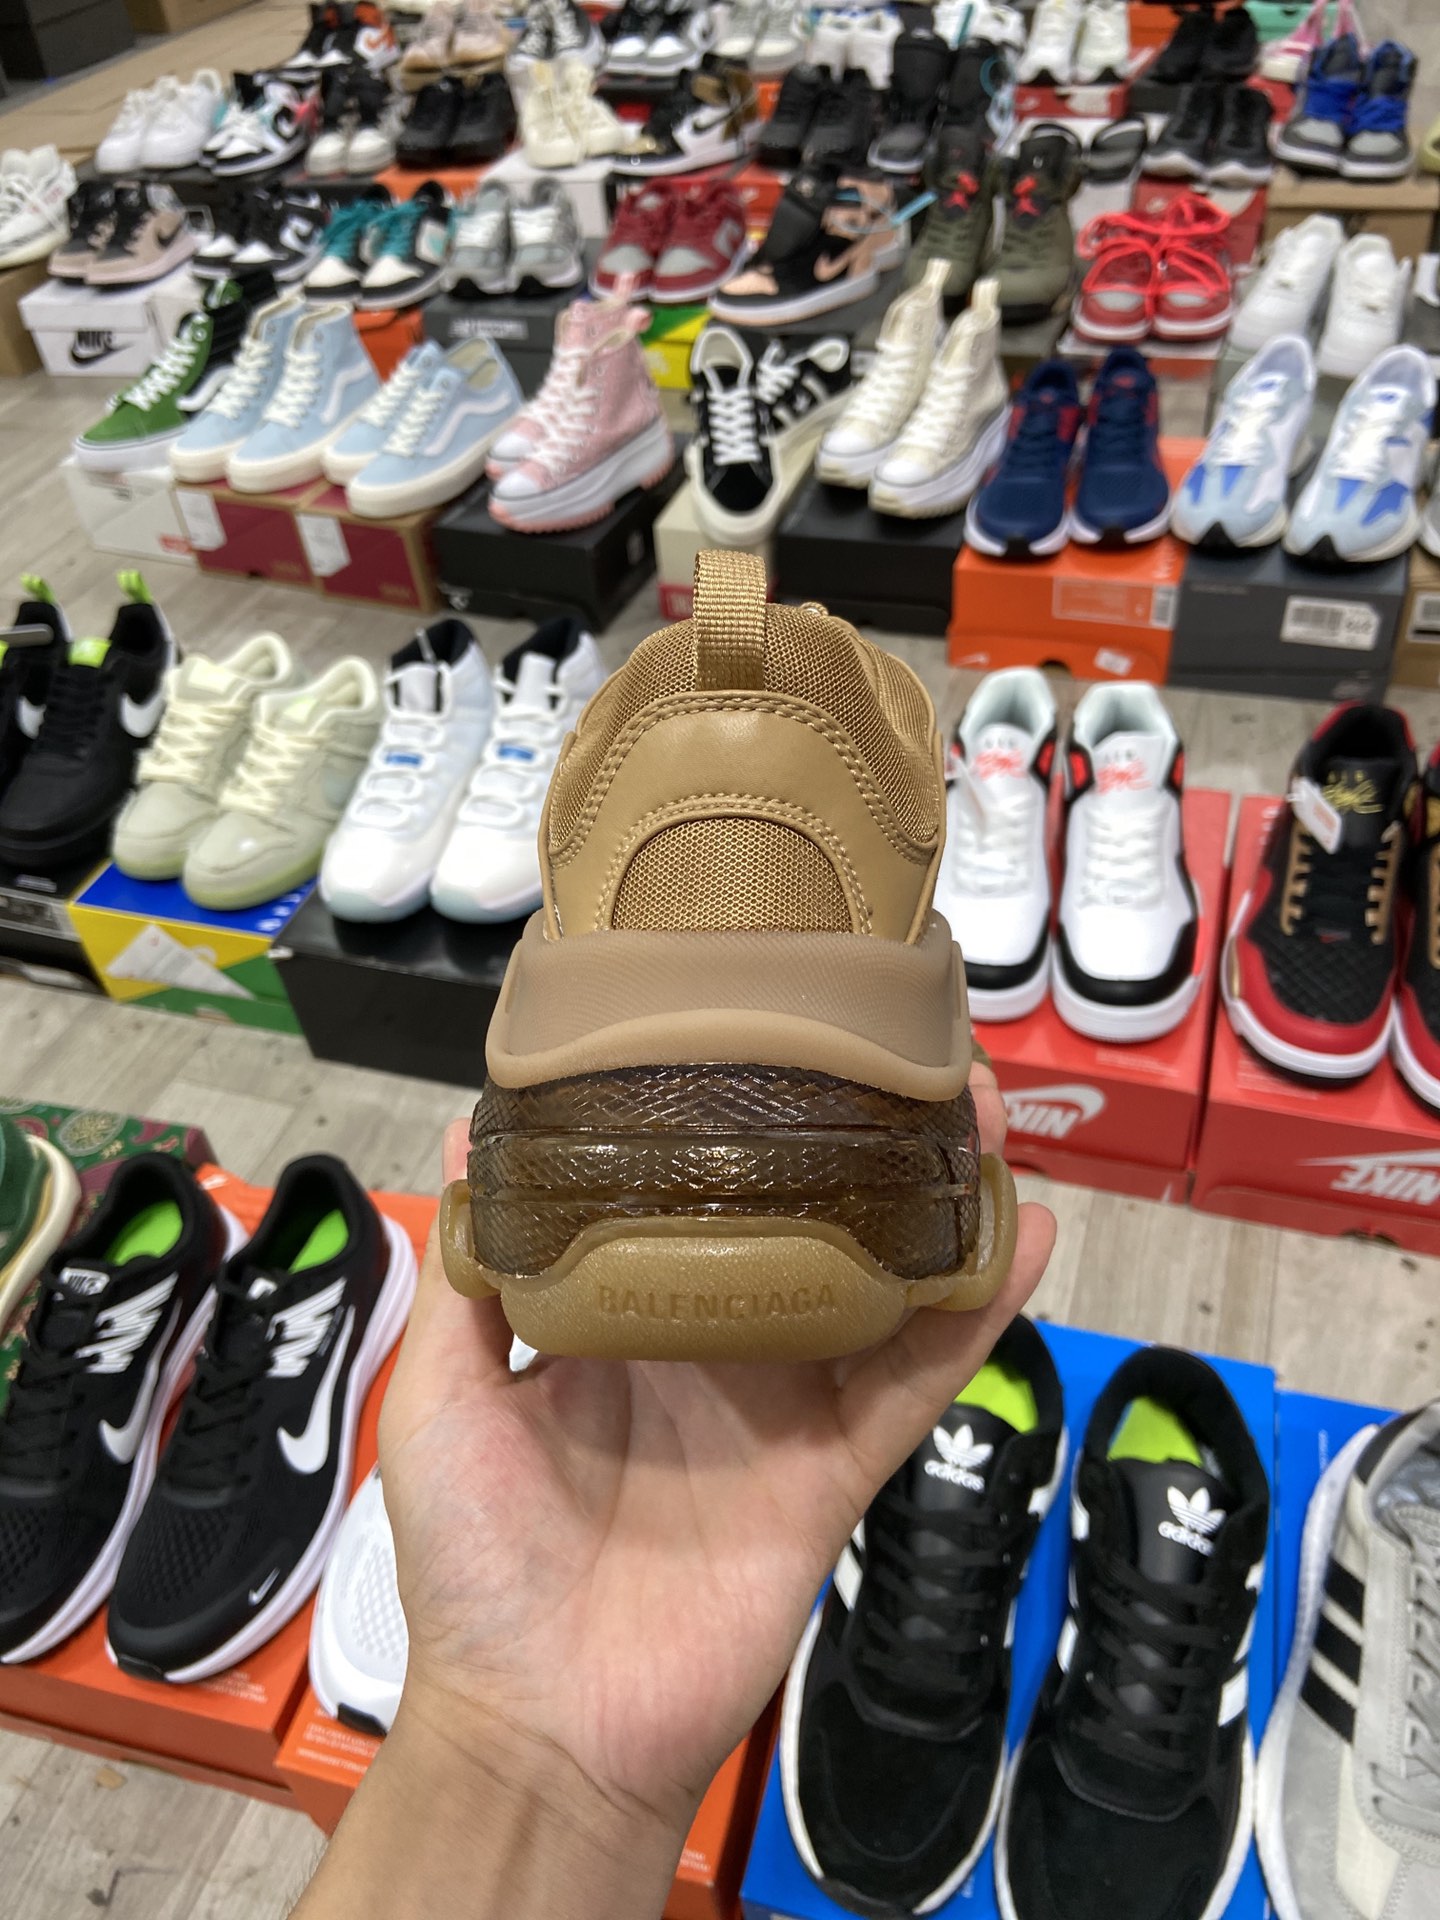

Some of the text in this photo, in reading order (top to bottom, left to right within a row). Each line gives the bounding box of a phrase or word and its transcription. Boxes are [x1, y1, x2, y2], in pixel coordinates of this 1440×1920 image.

[1003, 1101, 1080, 1139] NIK
[598, 1284, 836, 1320] BALENCIAGA
[924, 1460, 985, 1493] adidas
